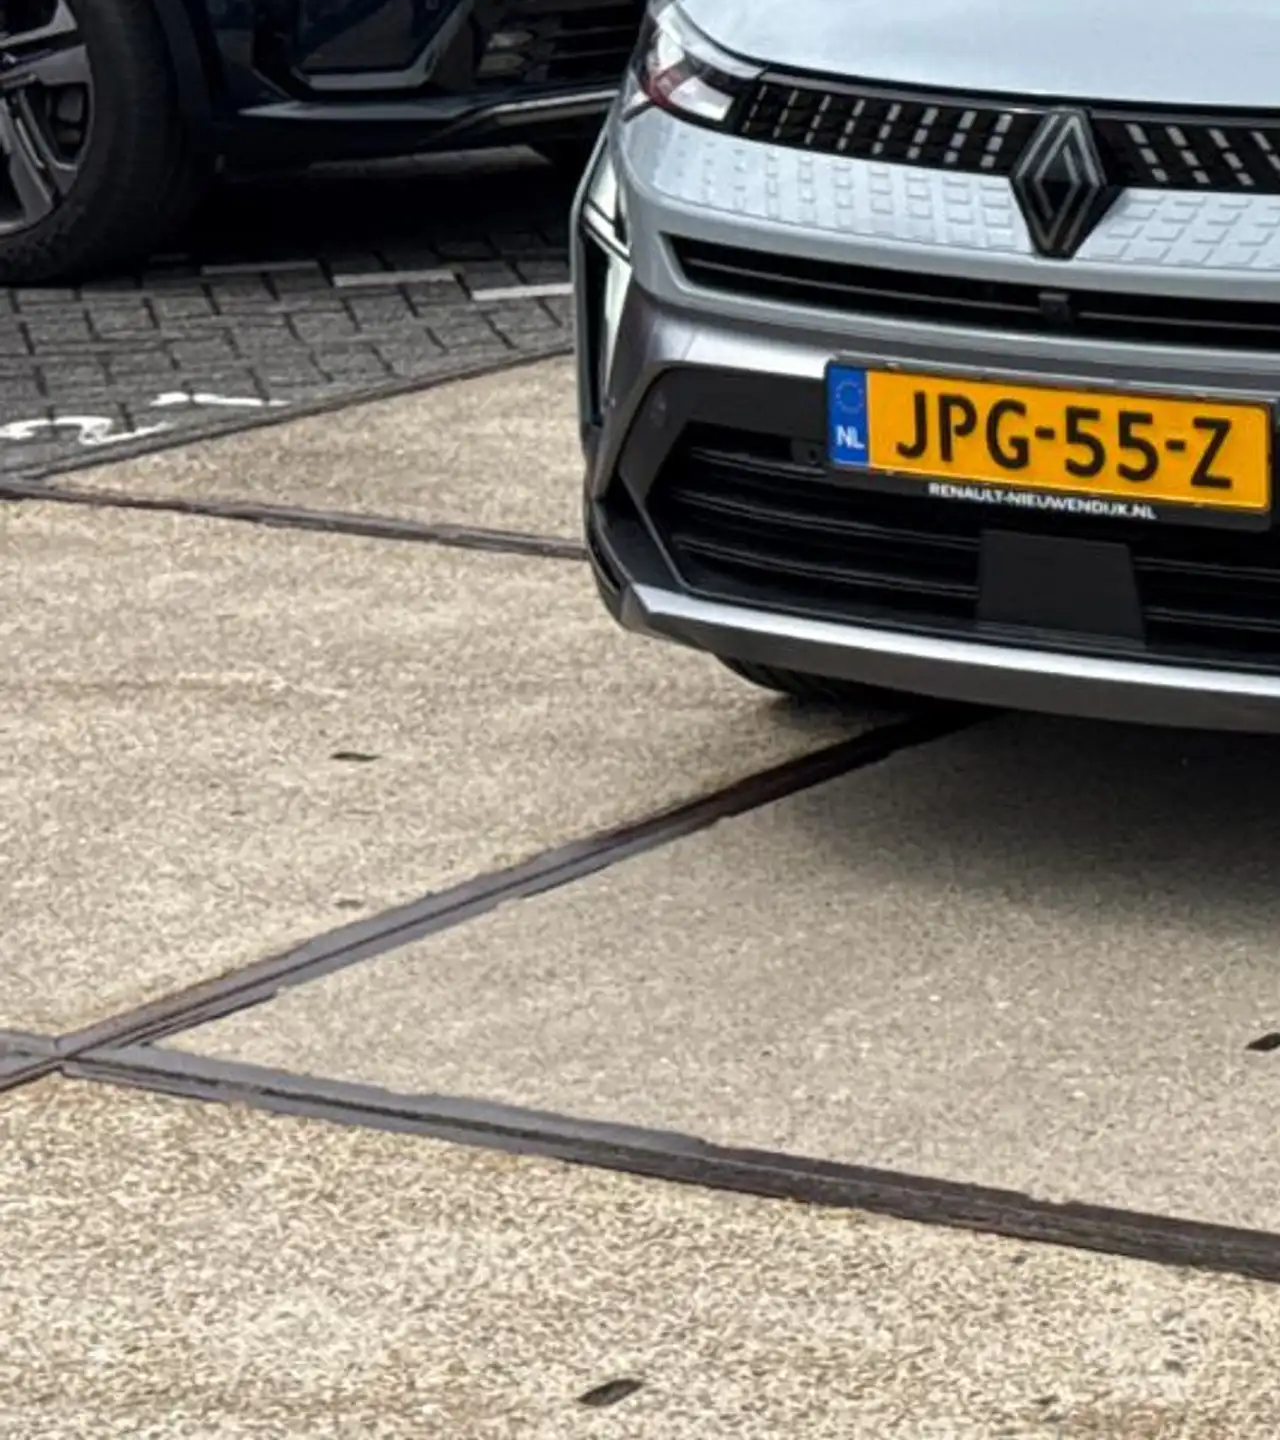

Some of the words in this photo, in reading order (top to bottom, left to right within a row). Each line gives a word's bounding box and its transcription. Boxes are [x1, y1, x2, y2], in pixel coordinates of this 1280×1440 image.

[836, 425, 865, 449] NL
[895, 390, 1233, 490] JPG-55-Z
[928, 482, 1158, 520] RENAULT-NIEUWENDIJK.NL
